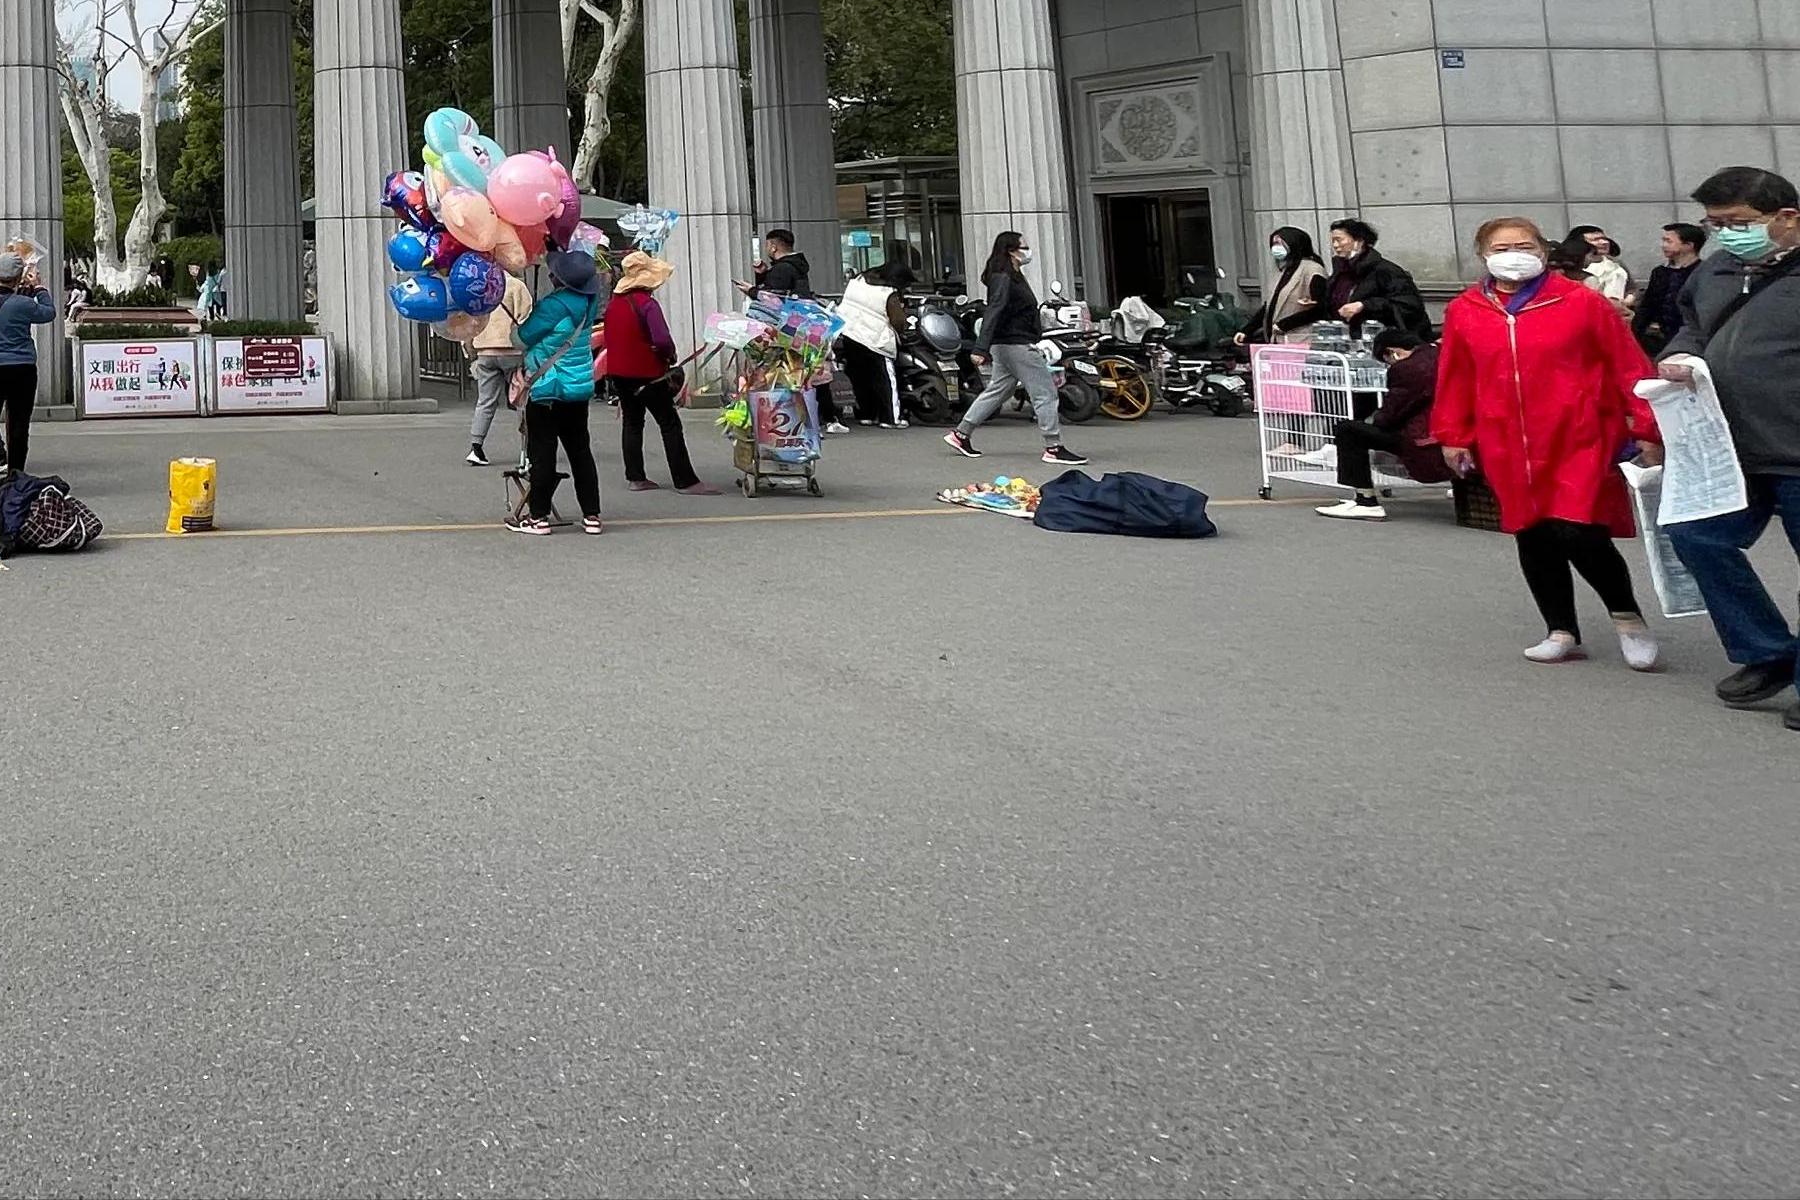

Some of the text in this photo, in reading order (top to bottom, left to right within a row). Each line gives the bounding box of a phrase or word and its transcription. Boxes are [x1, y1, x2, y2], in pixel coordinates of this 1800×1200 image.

[89, 359, 141, 375] 文明出行
[89, 376, 141, 391] 从我做起
